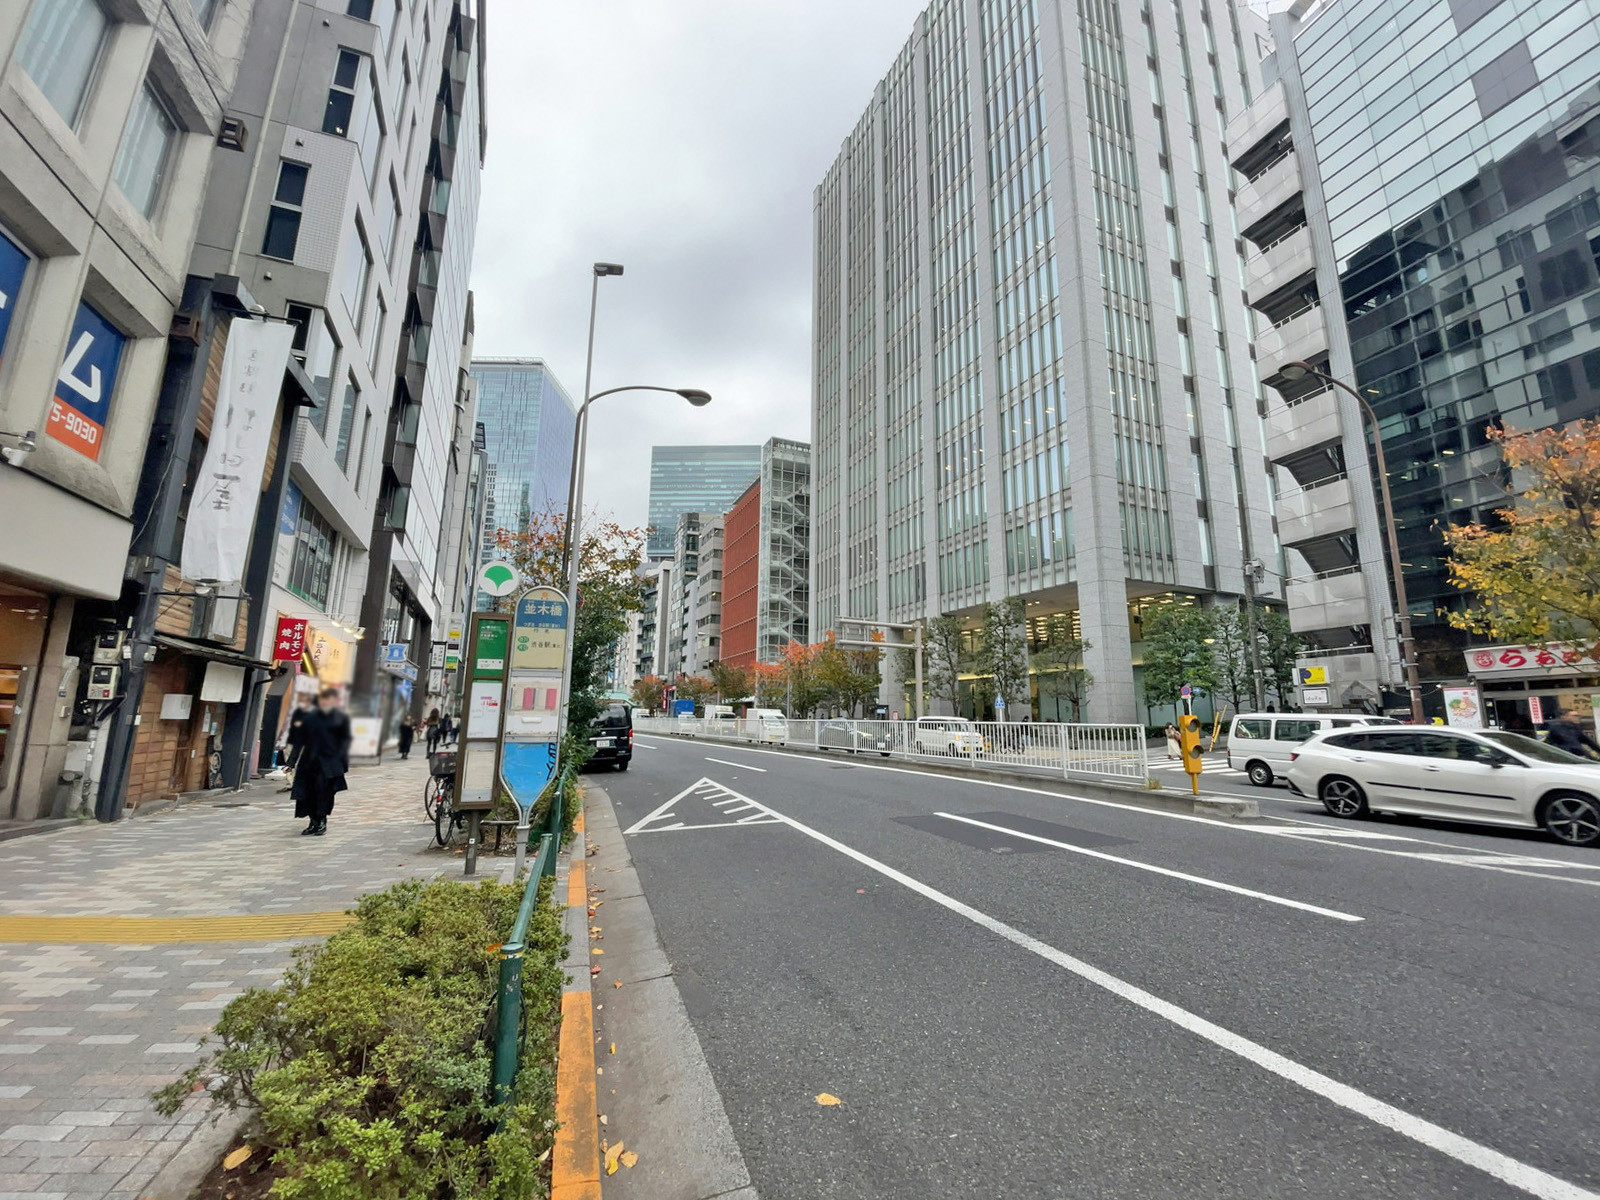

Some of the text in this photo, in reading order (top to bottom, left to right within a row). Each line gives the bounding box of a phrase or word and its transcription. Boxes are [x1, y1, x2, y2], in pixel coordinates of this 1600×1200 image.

[524, 603, 562, 617] 並木橋
[279, 628, 292, 649] 焼肉
[291, 623, 304, 657] ホルモン
